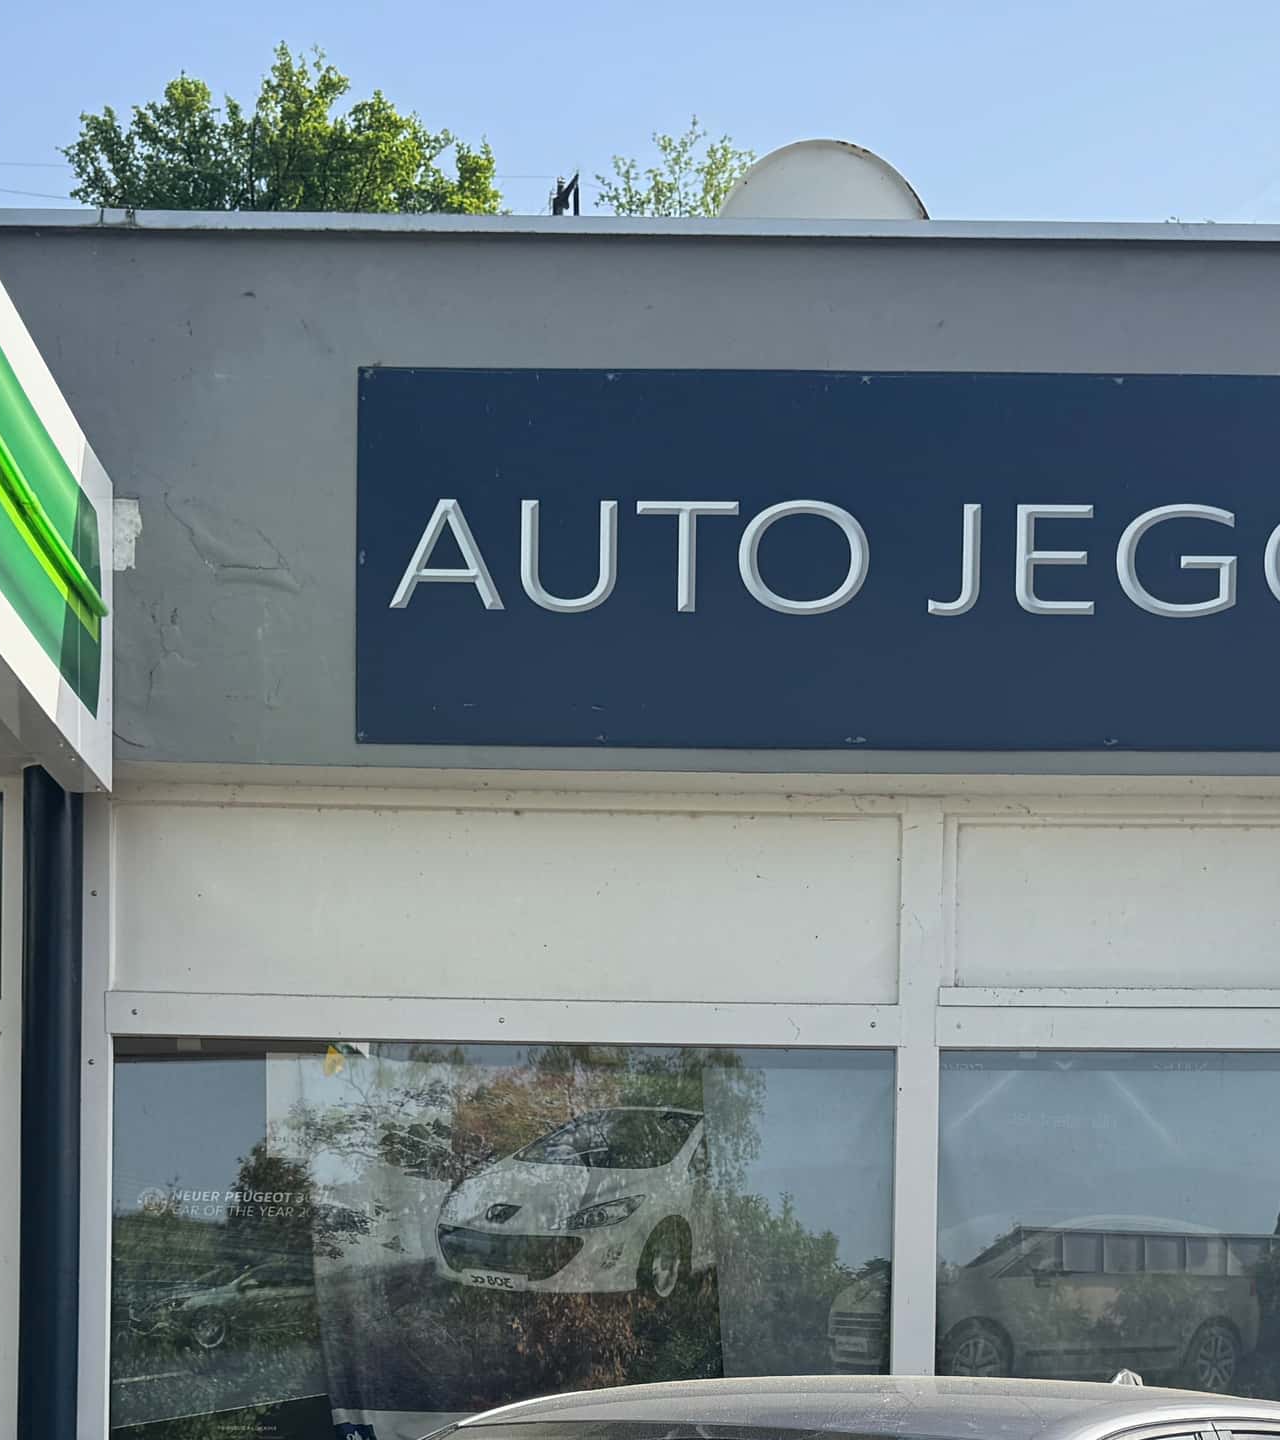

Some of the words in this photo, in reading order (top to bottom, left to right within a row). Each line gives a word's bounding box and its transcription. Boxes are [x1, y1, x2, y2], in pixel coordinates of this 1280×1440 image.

[389, 498, 871, 616] AUTO
[172, 1189, 221, 1202] NEUER
[224, 1190, 293, 1203] PEUGEOT
[229, 1205, 254, 1218] THE
[259, 1205, 294, 1218] YEAR
